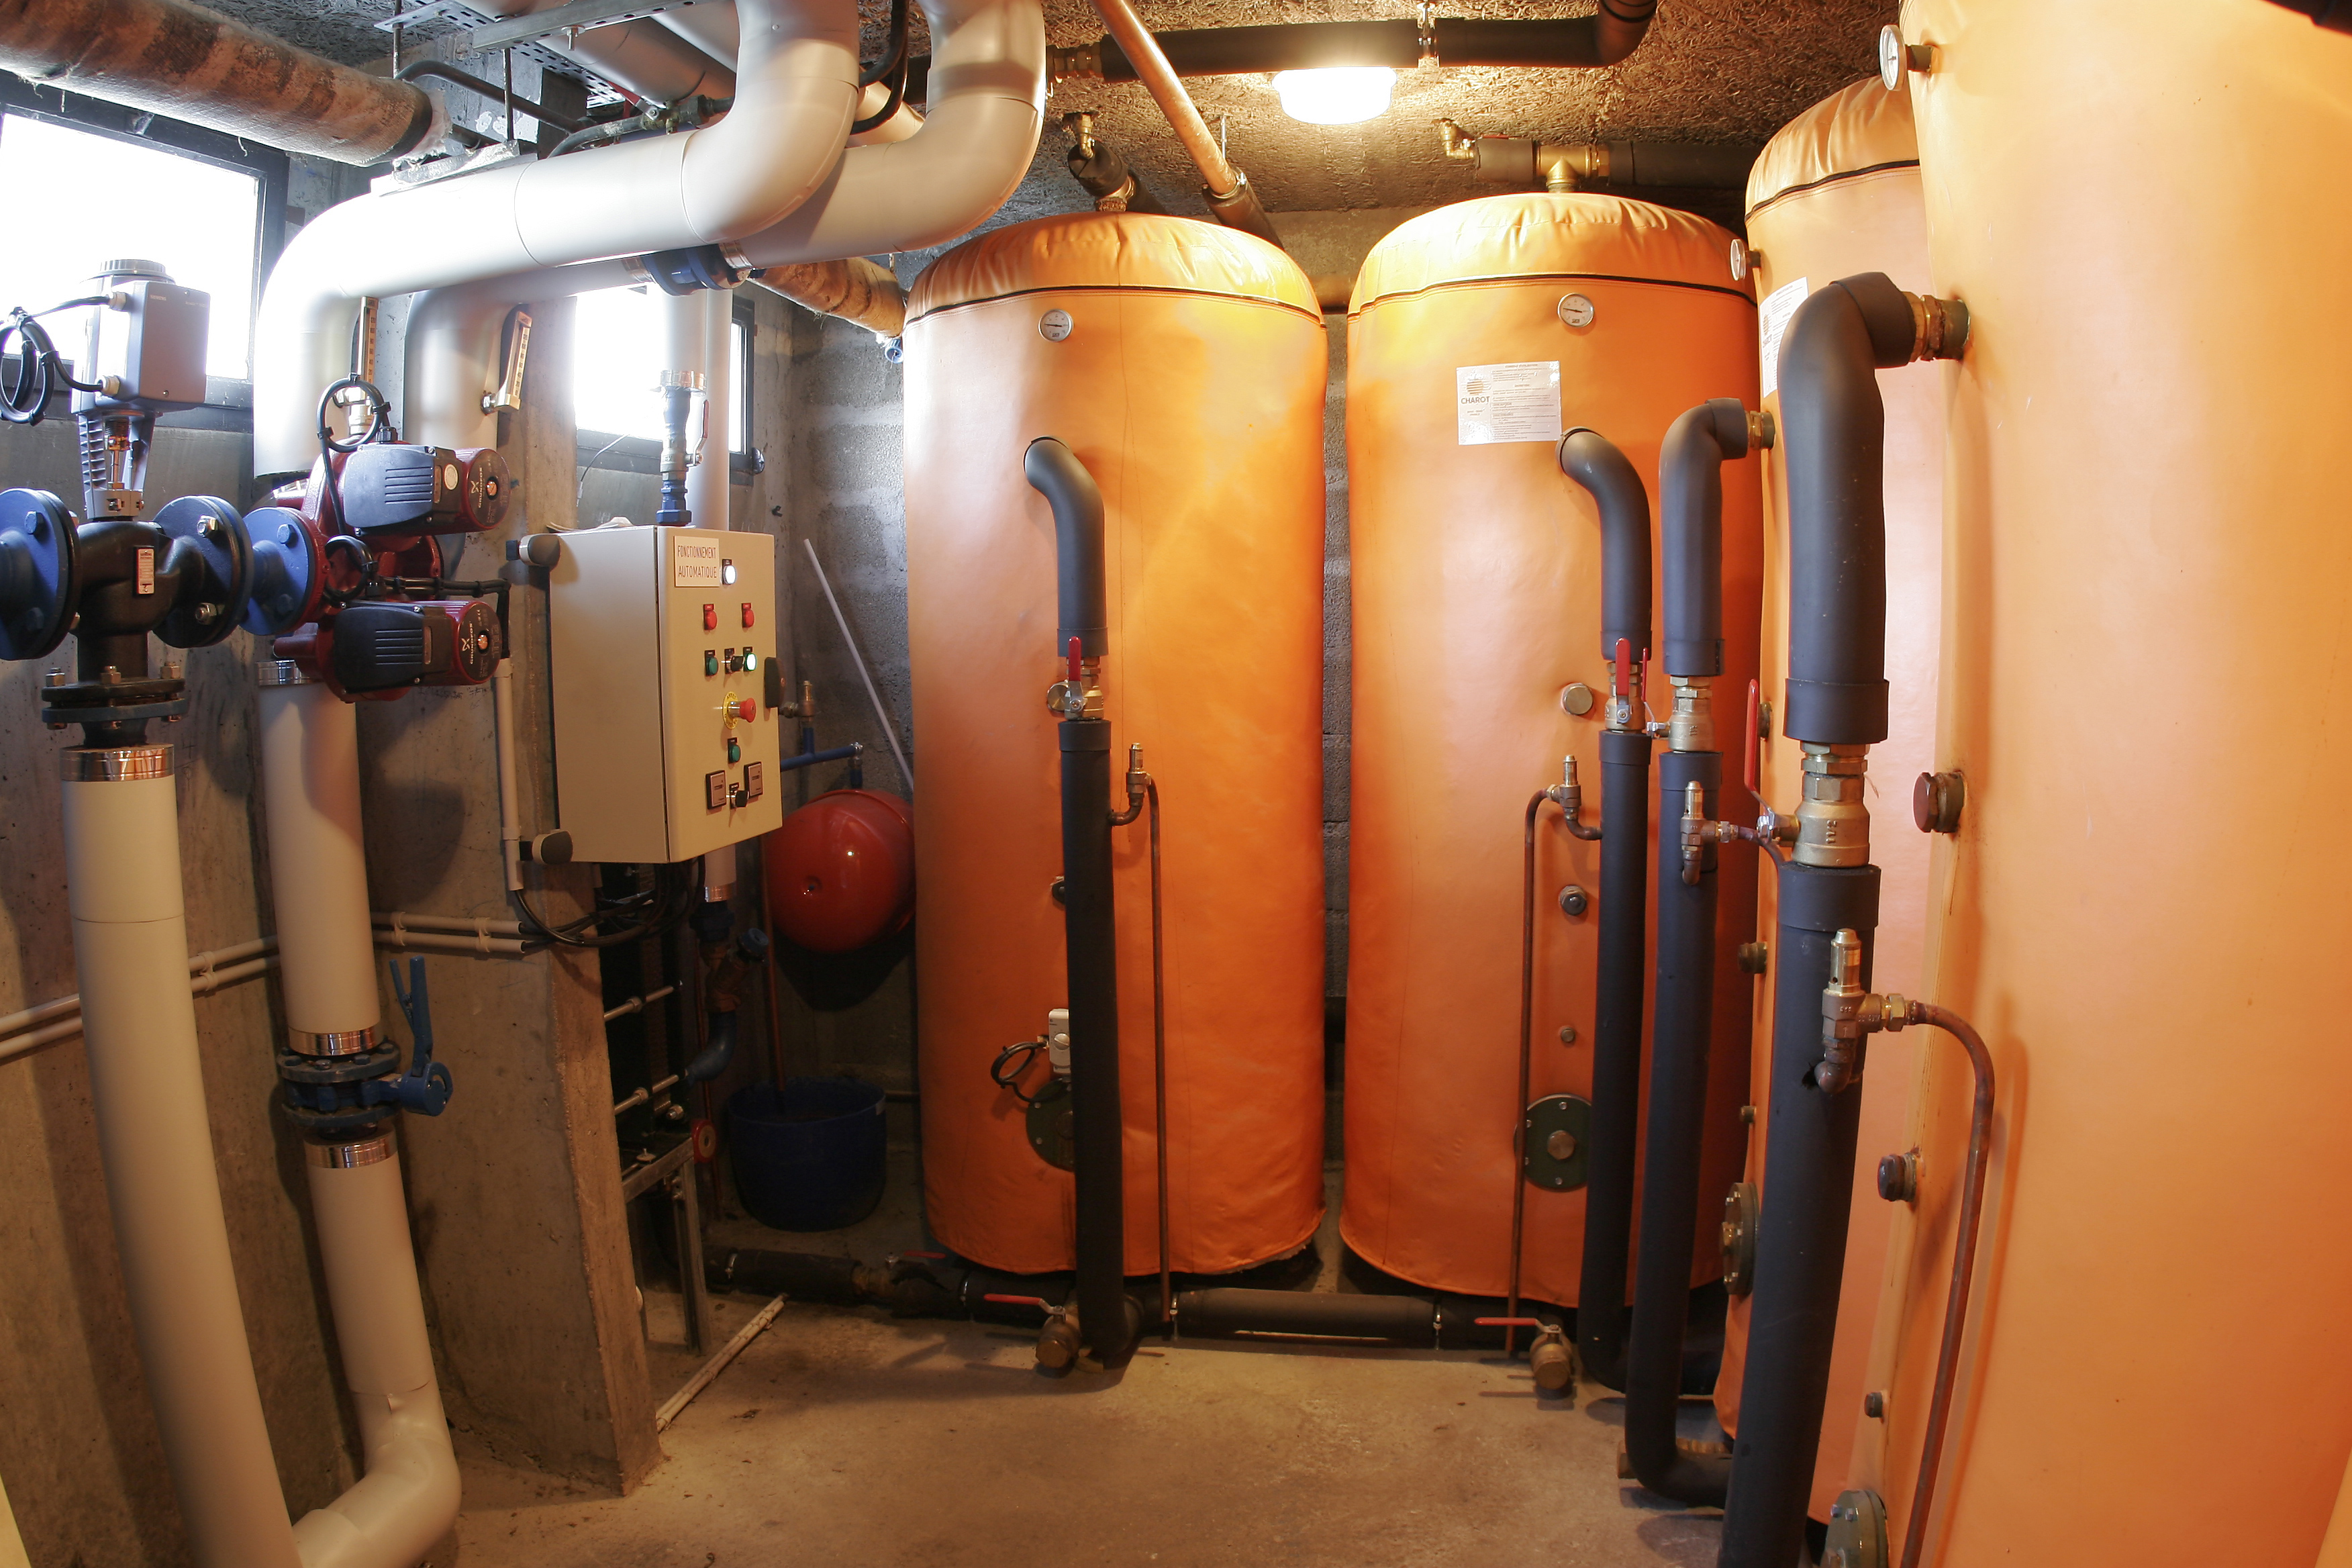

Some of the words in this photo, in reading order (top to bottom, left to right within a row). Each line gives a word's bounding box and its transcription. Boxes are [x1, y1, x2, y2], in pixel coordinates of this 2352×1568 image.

[1461, 395, 1490, 404] CHAROT
[677, 545, 716, 558] FONCTIONNEMENT
[678, 565, 718, 579] AUTOMATIQUE
